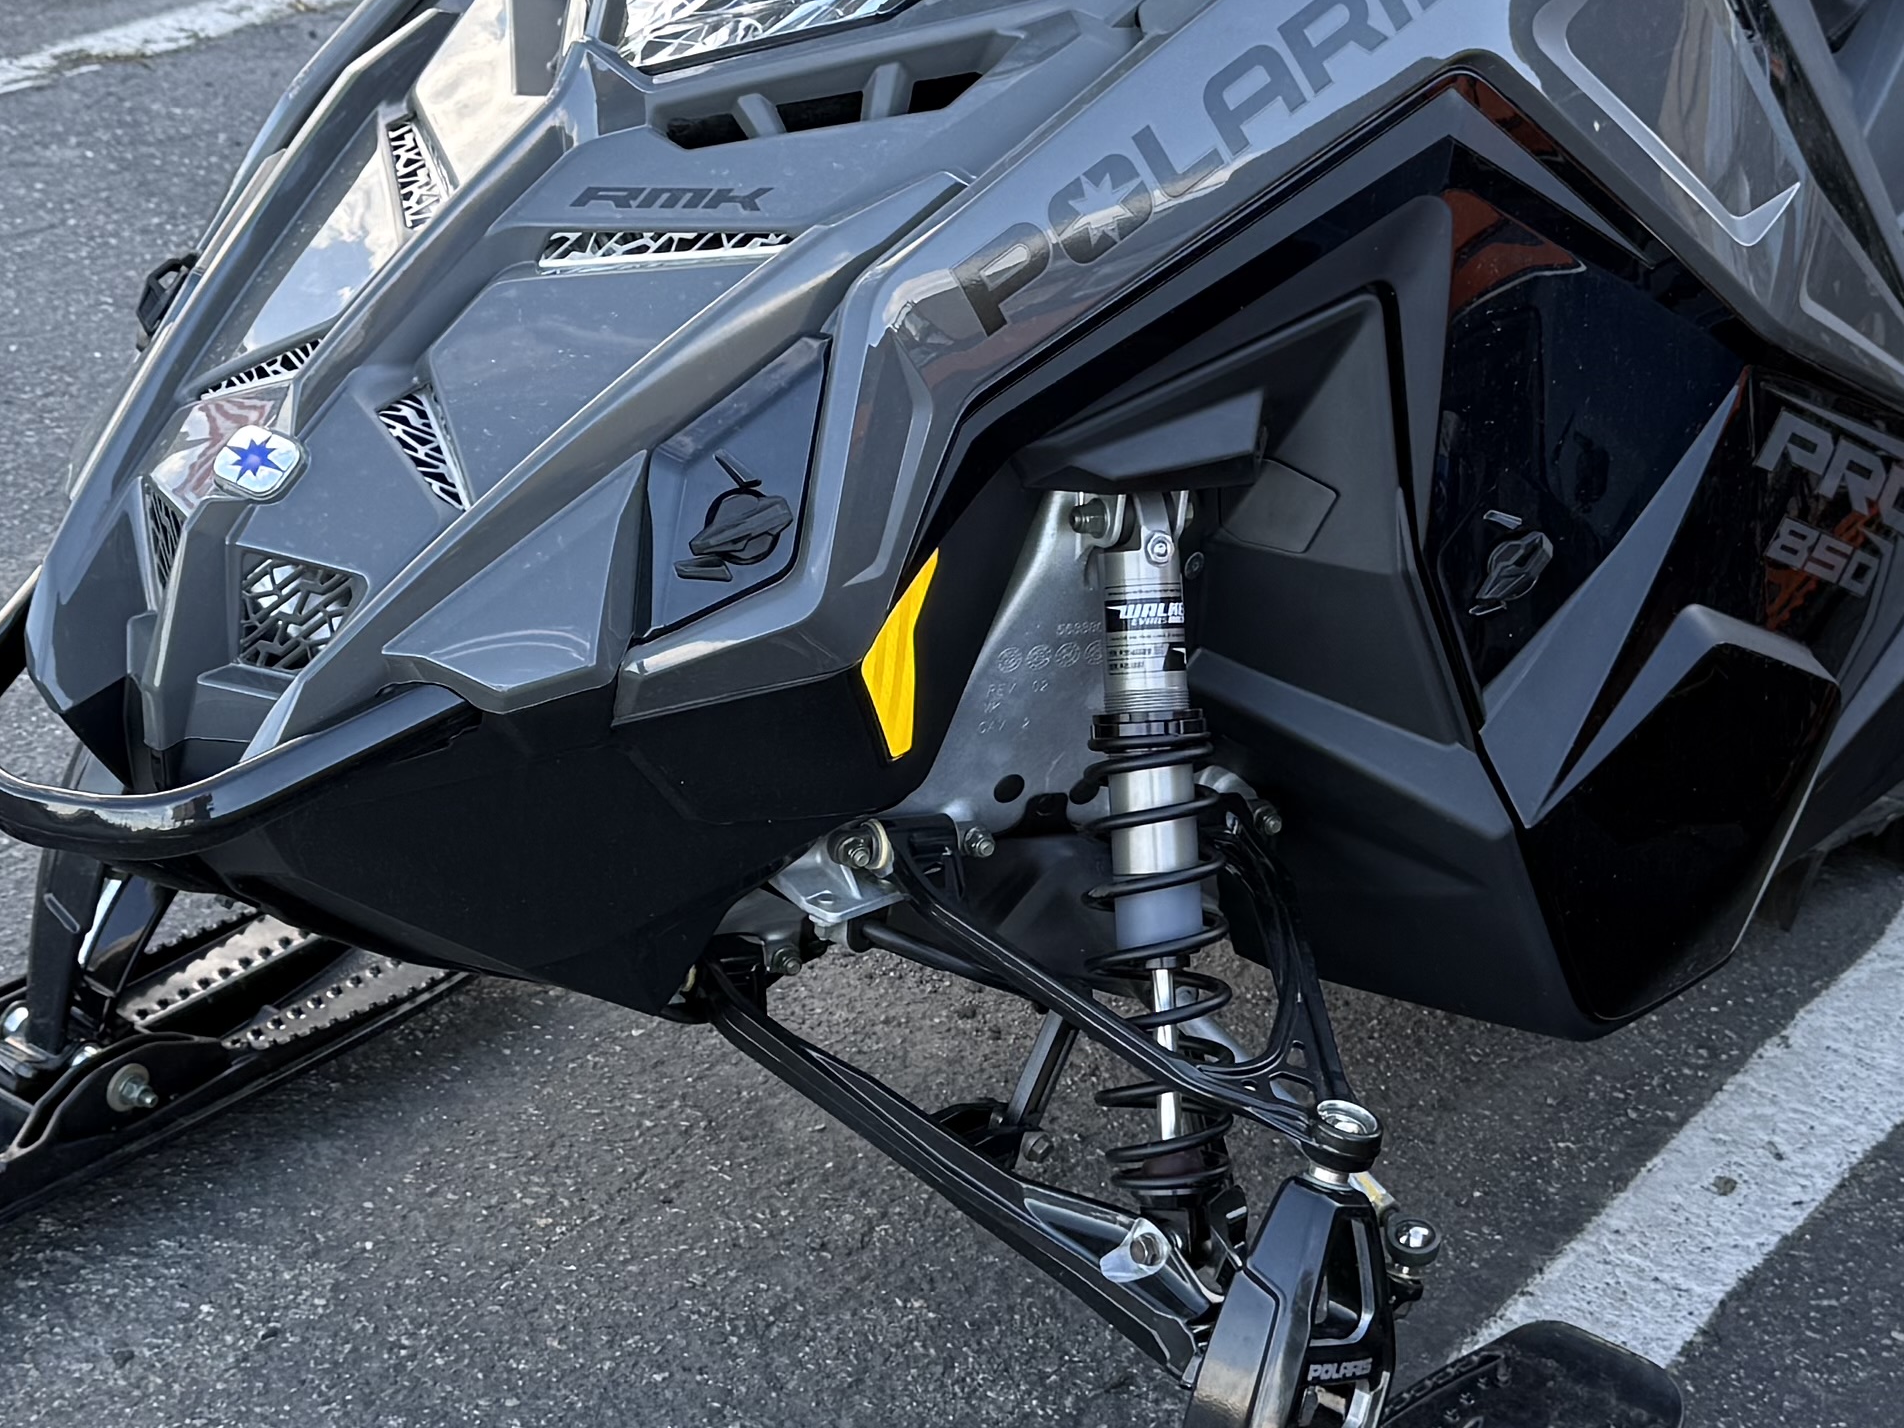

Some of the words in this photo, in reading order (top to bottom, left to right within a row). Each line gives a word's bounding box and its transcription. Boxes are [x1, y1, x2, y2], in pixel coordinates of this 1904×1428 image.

[569, 185, 776, 212] RMK
[1764, 515, 1882, 597] 850
[1307, 1357, 1373, 1382] POLARIS
